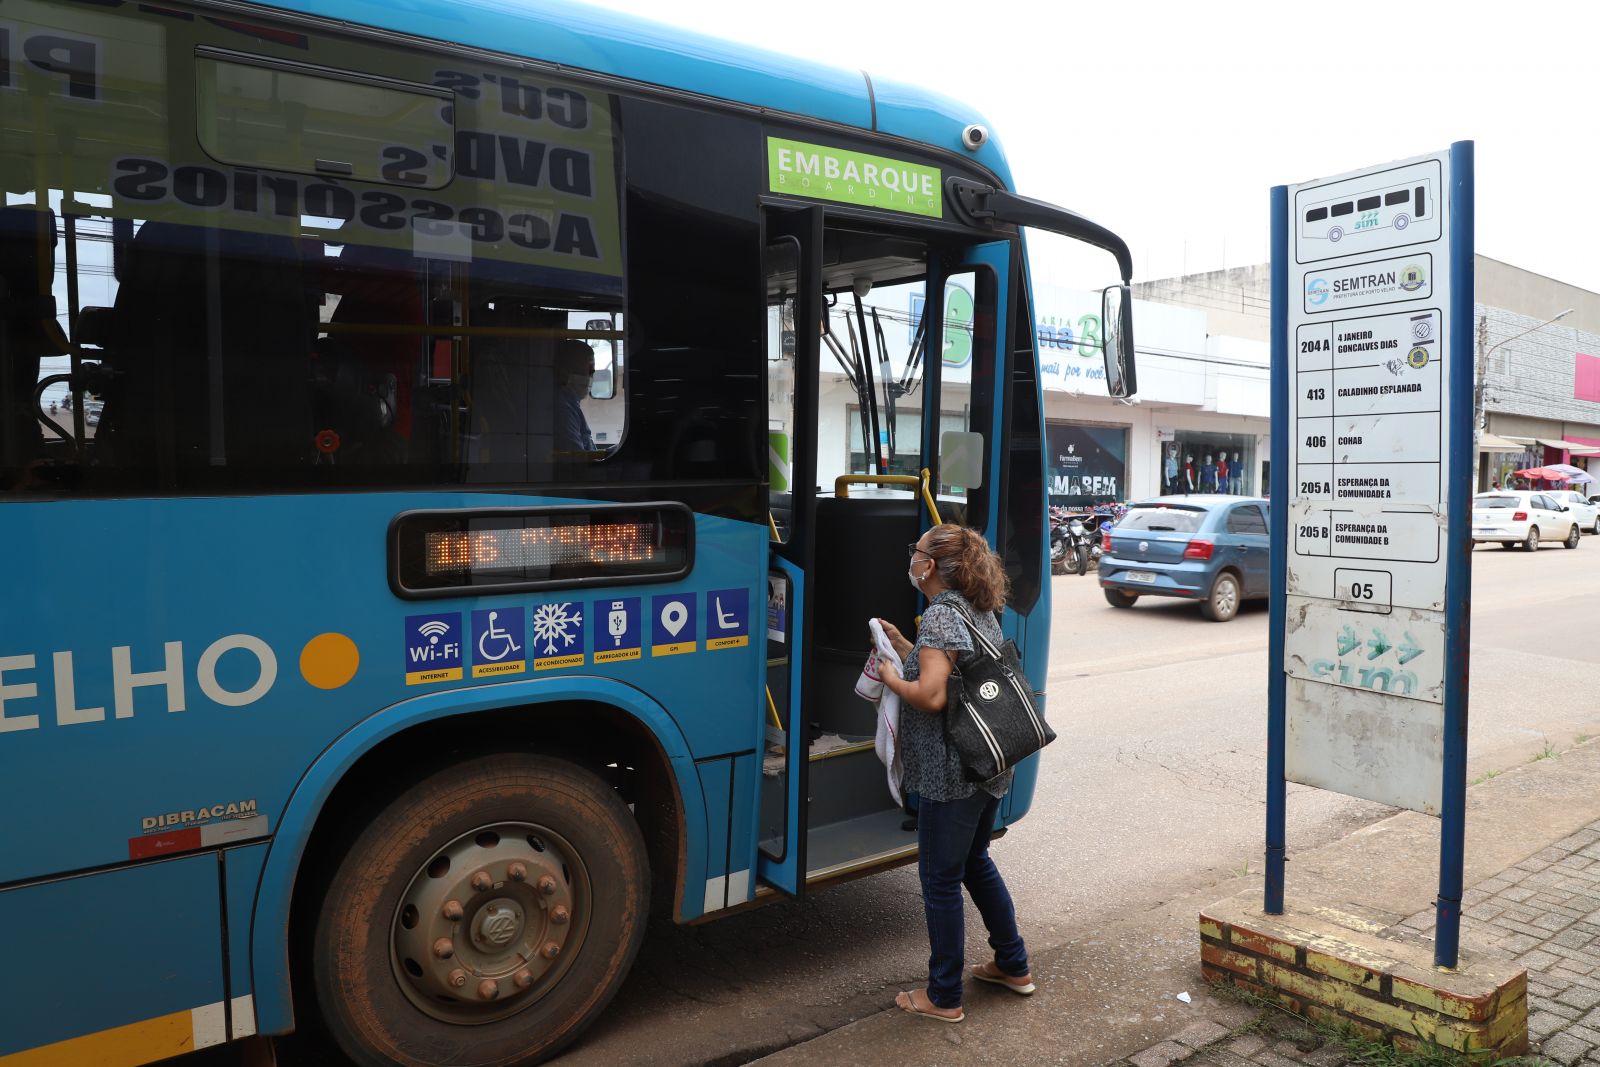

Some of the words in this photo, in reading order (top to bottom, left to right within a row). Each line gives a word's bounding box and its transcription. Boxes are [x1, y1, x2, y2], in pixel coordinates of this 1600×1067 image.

[777, 147, 934, 196] EMBARQUE
[779, 174, 935, 209] BOARDING
[1333, 271, 1396, 293] SEMTRAN
[1333, 291, 1358, 299] PREFEITURA
[1365, 288, 1380, 296] PORTO
[1338, 334, 1343, 342] 4
[1344, 331, 1373, 341] JANEIRO
[1301, 340, 1320, 353] 204
[1323, 339, 1330, 351] A
[1380, 339, 1398, 350] DIAS
[1064, 363, 1081, 381] por
[1307, 388, 1325, 401] 413
[1338, 386, 1378, 397] CALADINHO
[1380, 383, 1422, 395] ESPLANADA
[1305, 435, 1326, 448] 406
[1338, 437, 1363, 445] COHAB
[1301, 482, 1322, 494] 205
[1323, 482, 1330, 494] A
[1338, 478, 1377, 488] ESPERANÇA
[1379, 478, 1390, 487] DA
[1338, 489, 1383, 498] COMUNIDADE
[1385, 489, 1391, 498] A
[1300, 526, 1321, 538] 205
[1322, 526, 1329, 539] B
[1335, 523, 1375, 534] ESPERANÇA
[1376, 524, 1387, 533] DA
[436, 534, 498, 565] 116
[521, 524, 637, 545] AVENIDA
[1335, 535, 1382, 545] COMUNIDADE
[1383, 536, 1389, 545] B
[1351, 582, 1374, 600] 05
[409, 643, 459, 663] Wi-Fi
[596, 652, 628, 662] CARREGADOR
[543, 656, 583, 667] CONDICIONADO
[478, 664, 520, 675] ACESSIBILIDADE
[420, 672, 449, 681] INTERNET
[142, 799, 257, 830] DIBRACAM
